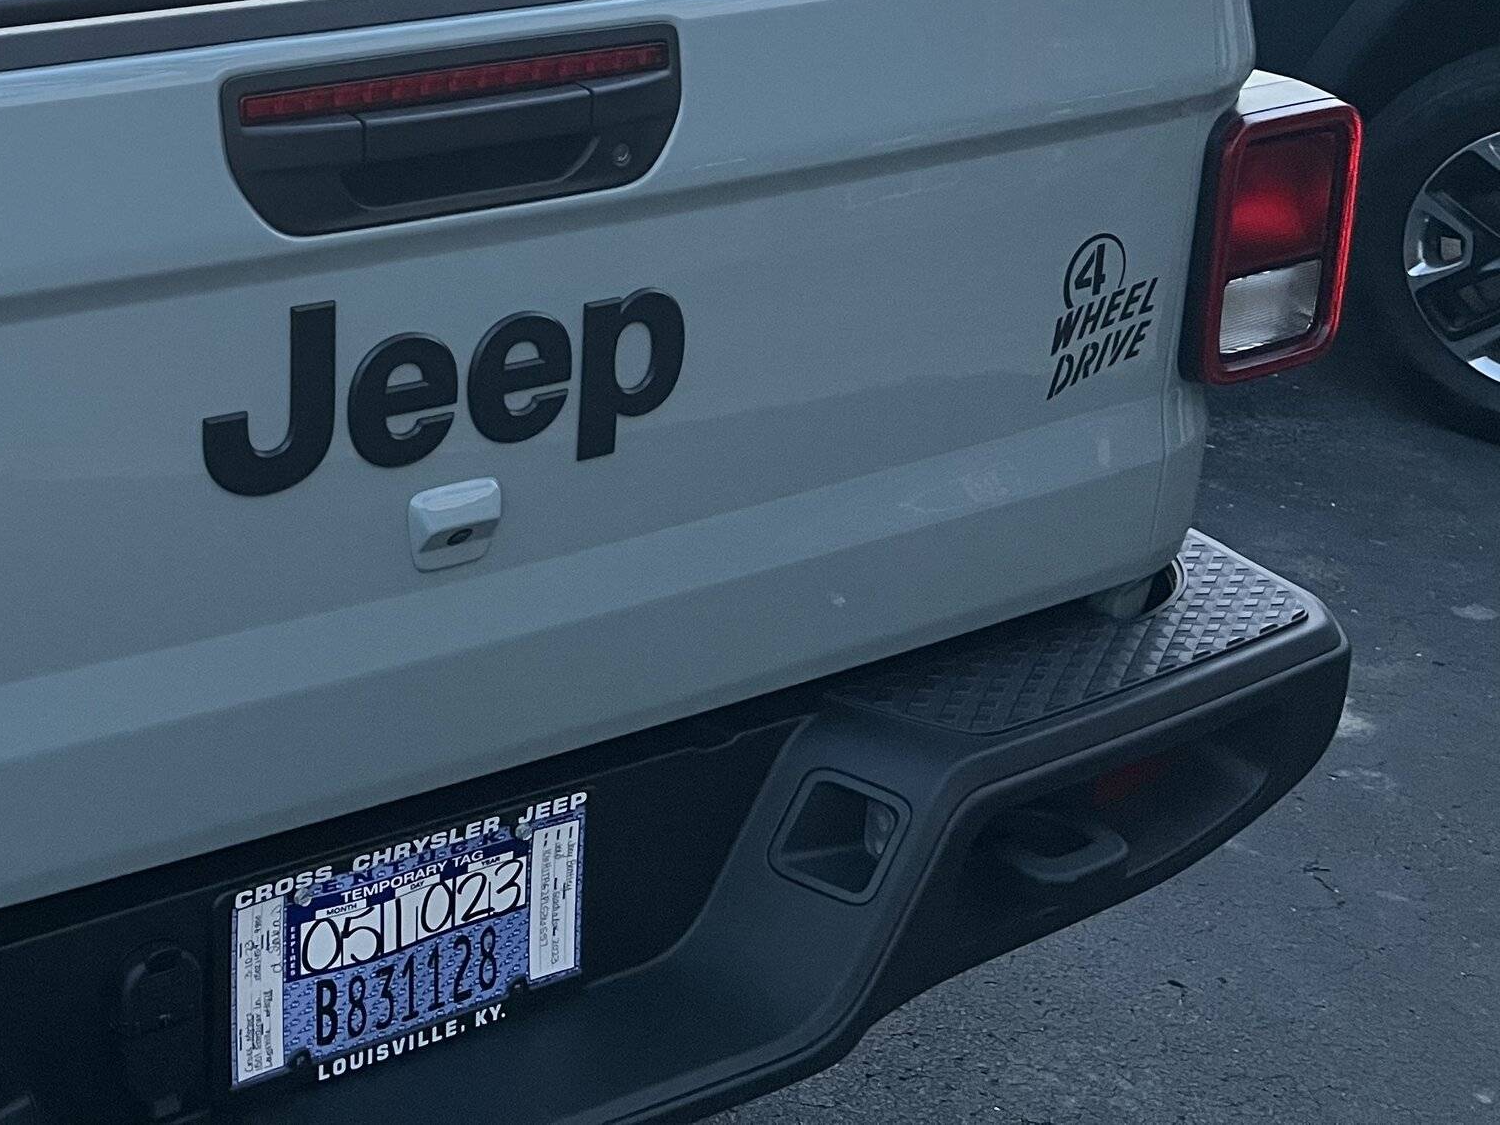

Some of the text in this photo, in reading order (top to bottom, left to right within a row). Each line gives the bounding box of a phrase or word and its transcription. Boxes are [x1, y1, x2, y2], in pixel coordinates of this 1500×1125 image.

[1074, 243, 1106, 296] 4
[1050, 277, 1159, 356] WHEEL
[202, 286, 685, 497] Jeep
[1046, 319, 1152, 400] DRIVE
[234, 791, 588, 909] CROSS CHRYSLER JEEP
[341, 850, 484, 903] TEMPORARY TAG
[410, 880, 425, 889] DAY
[326, 903, 357, 915] MONTH
[315, 926, 498, 1046] B831128
[318, 1019, 466, 1080] LOUISVILLE,
[475, 1004, 506, 1028] KY.
